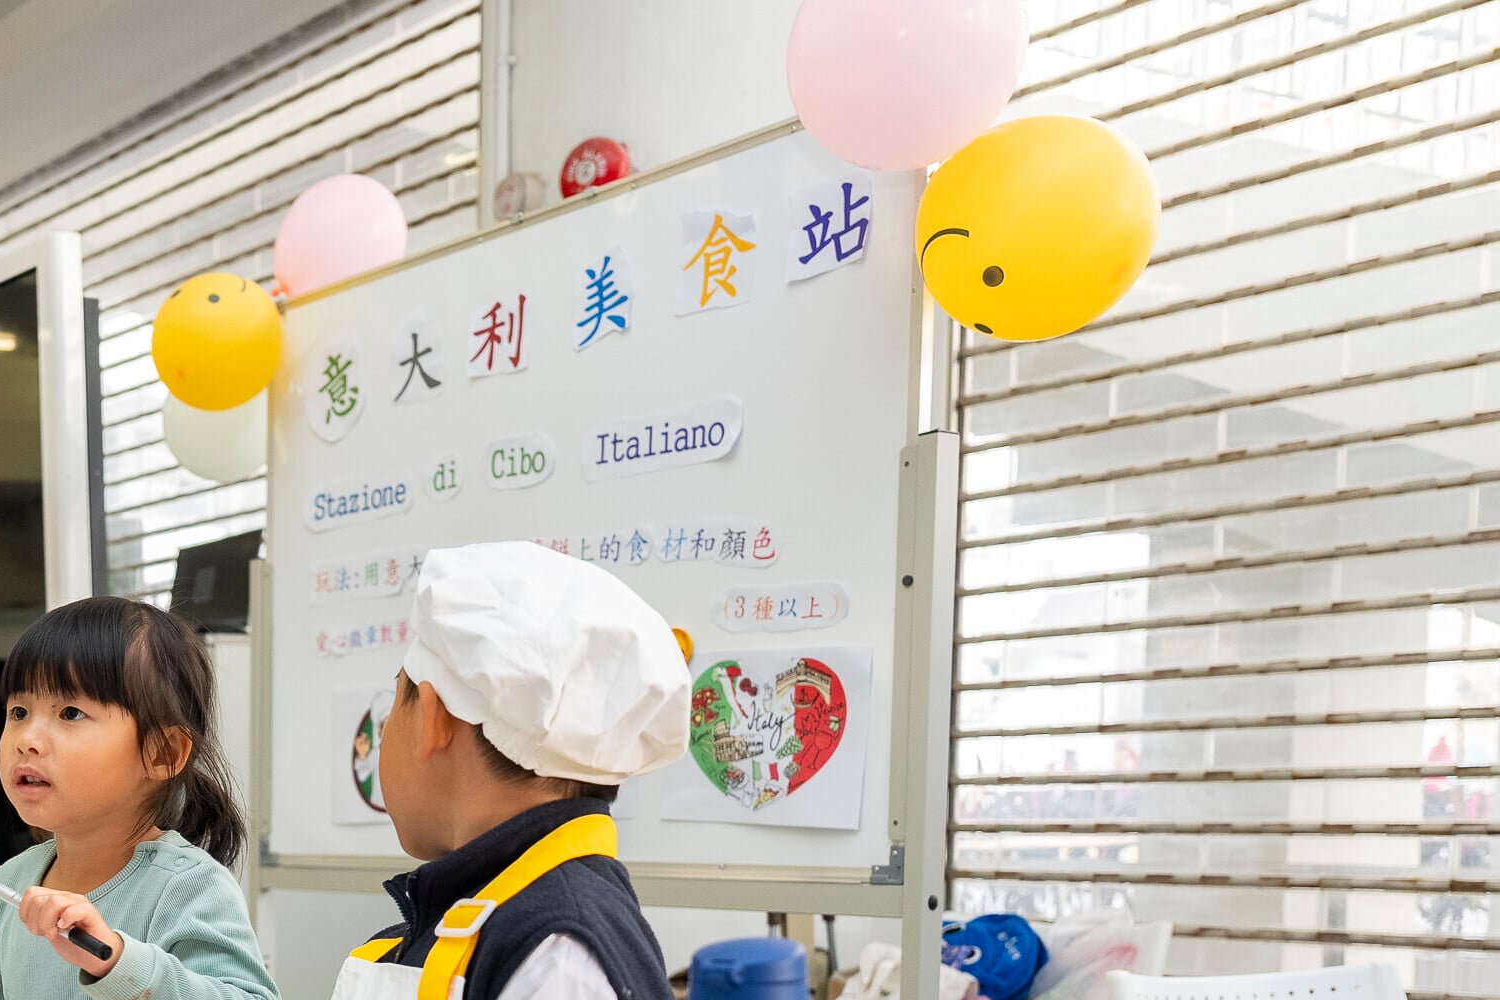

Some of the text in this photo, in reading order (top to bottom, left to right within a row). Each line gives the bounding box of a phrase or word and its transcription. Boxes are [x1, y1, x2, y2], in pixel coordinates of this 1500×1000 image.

[318, 182, 870, 423] 意大利美食站
[314, 416, 726, 520] Stazione di Cibo Italiano
[747, 700, 796, 751] Italy
